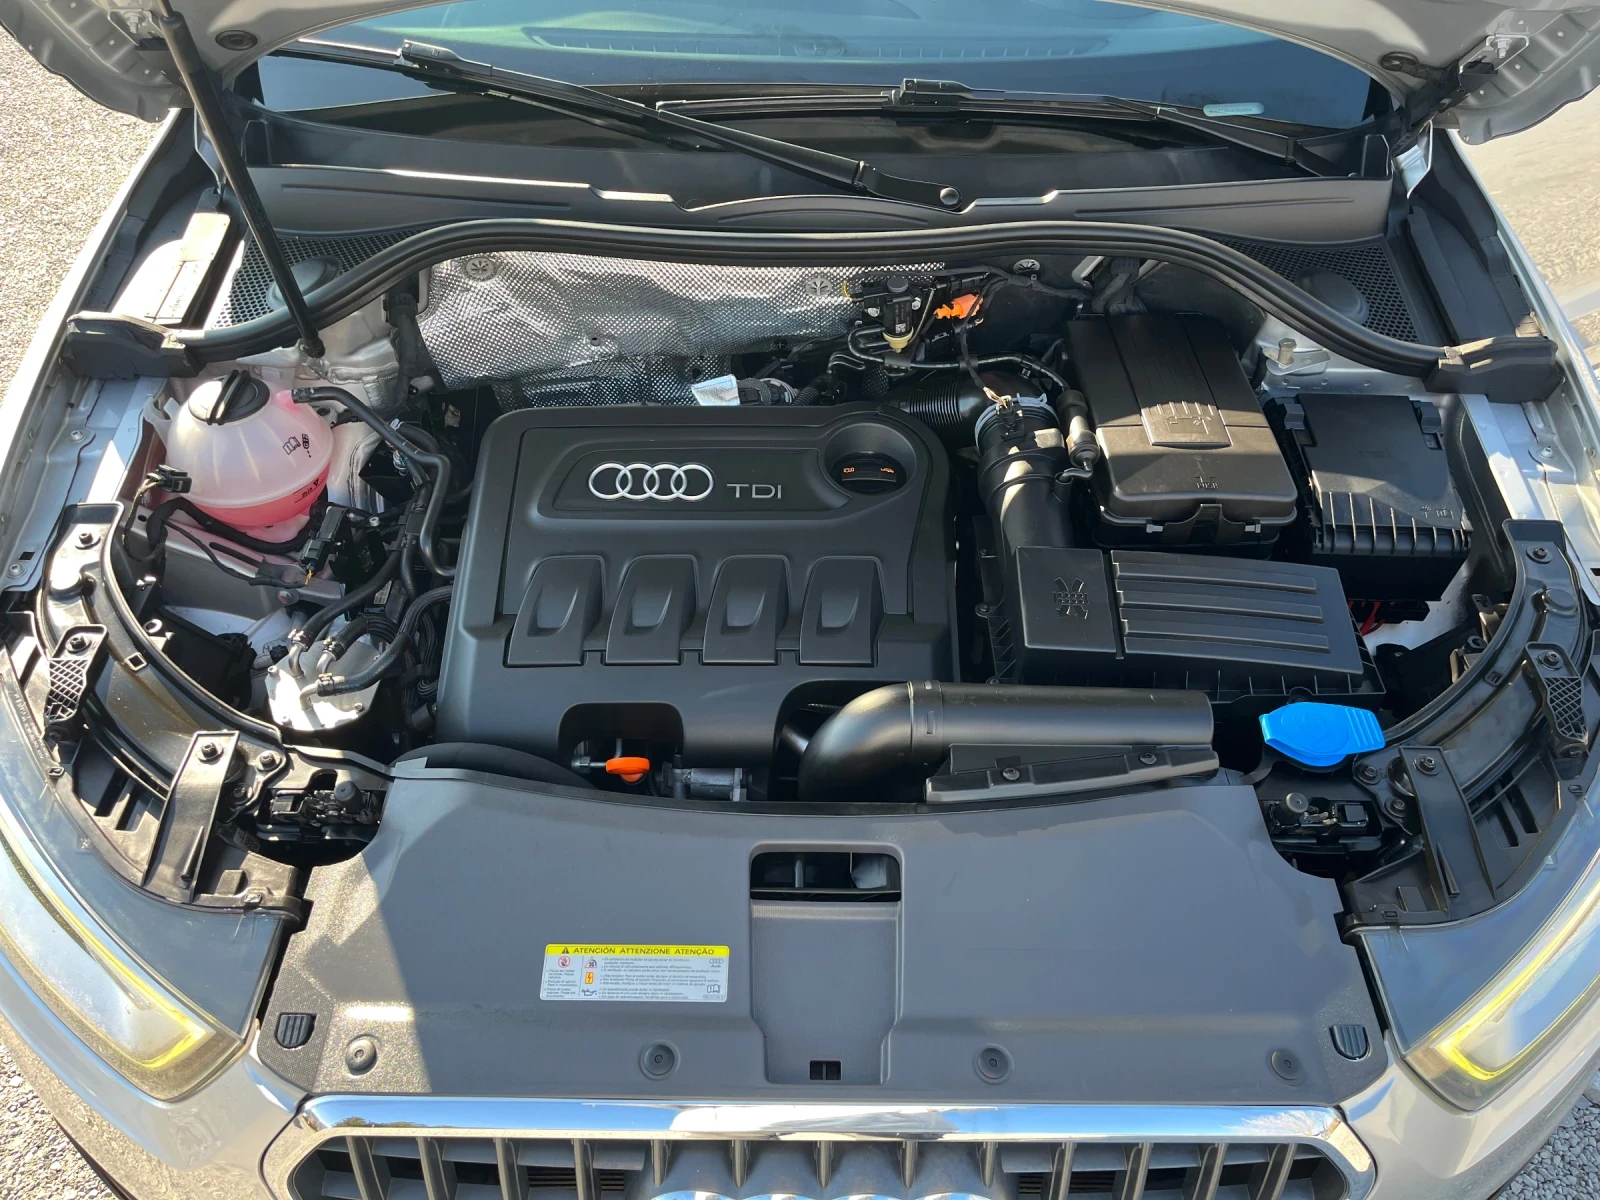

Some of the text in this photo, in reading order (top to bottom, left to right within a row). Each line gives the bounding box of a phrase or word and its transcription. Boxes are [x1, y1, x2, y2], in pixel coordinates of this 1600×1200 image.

[726, 483, 782, 499] TDI
[574, 946, 715, 956] ATENCIÓN ATTENZIONE ATENÇÃO
